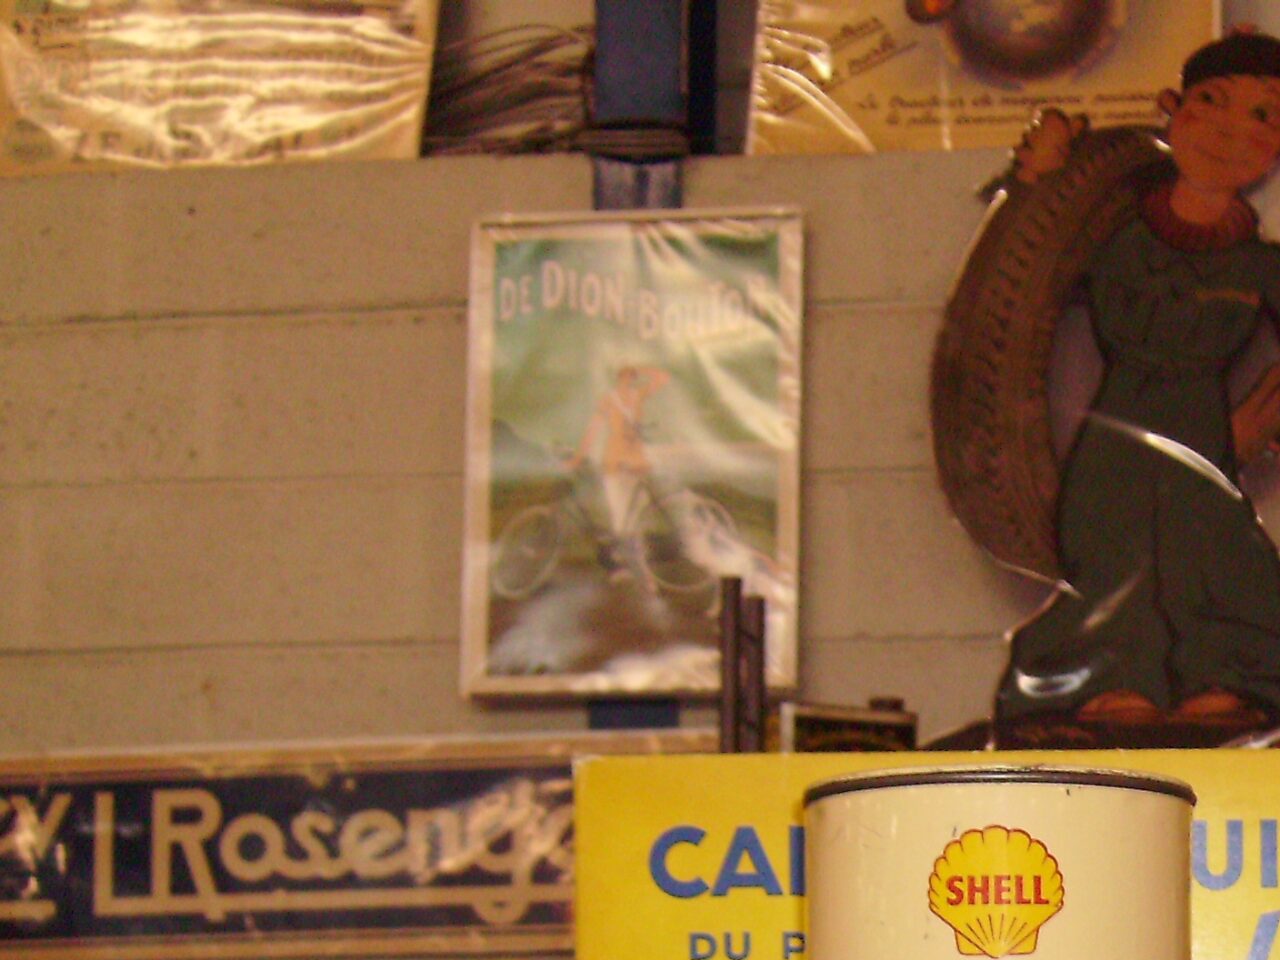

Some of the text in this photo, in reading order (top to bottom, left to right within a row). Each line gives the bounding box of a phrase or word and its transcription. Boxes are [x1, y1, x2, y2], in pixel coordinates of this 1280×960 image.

[499, 264, 535, 321] DE
[946, 874, 1050, 906] SHELL
[783, 932, 806, 960] P
